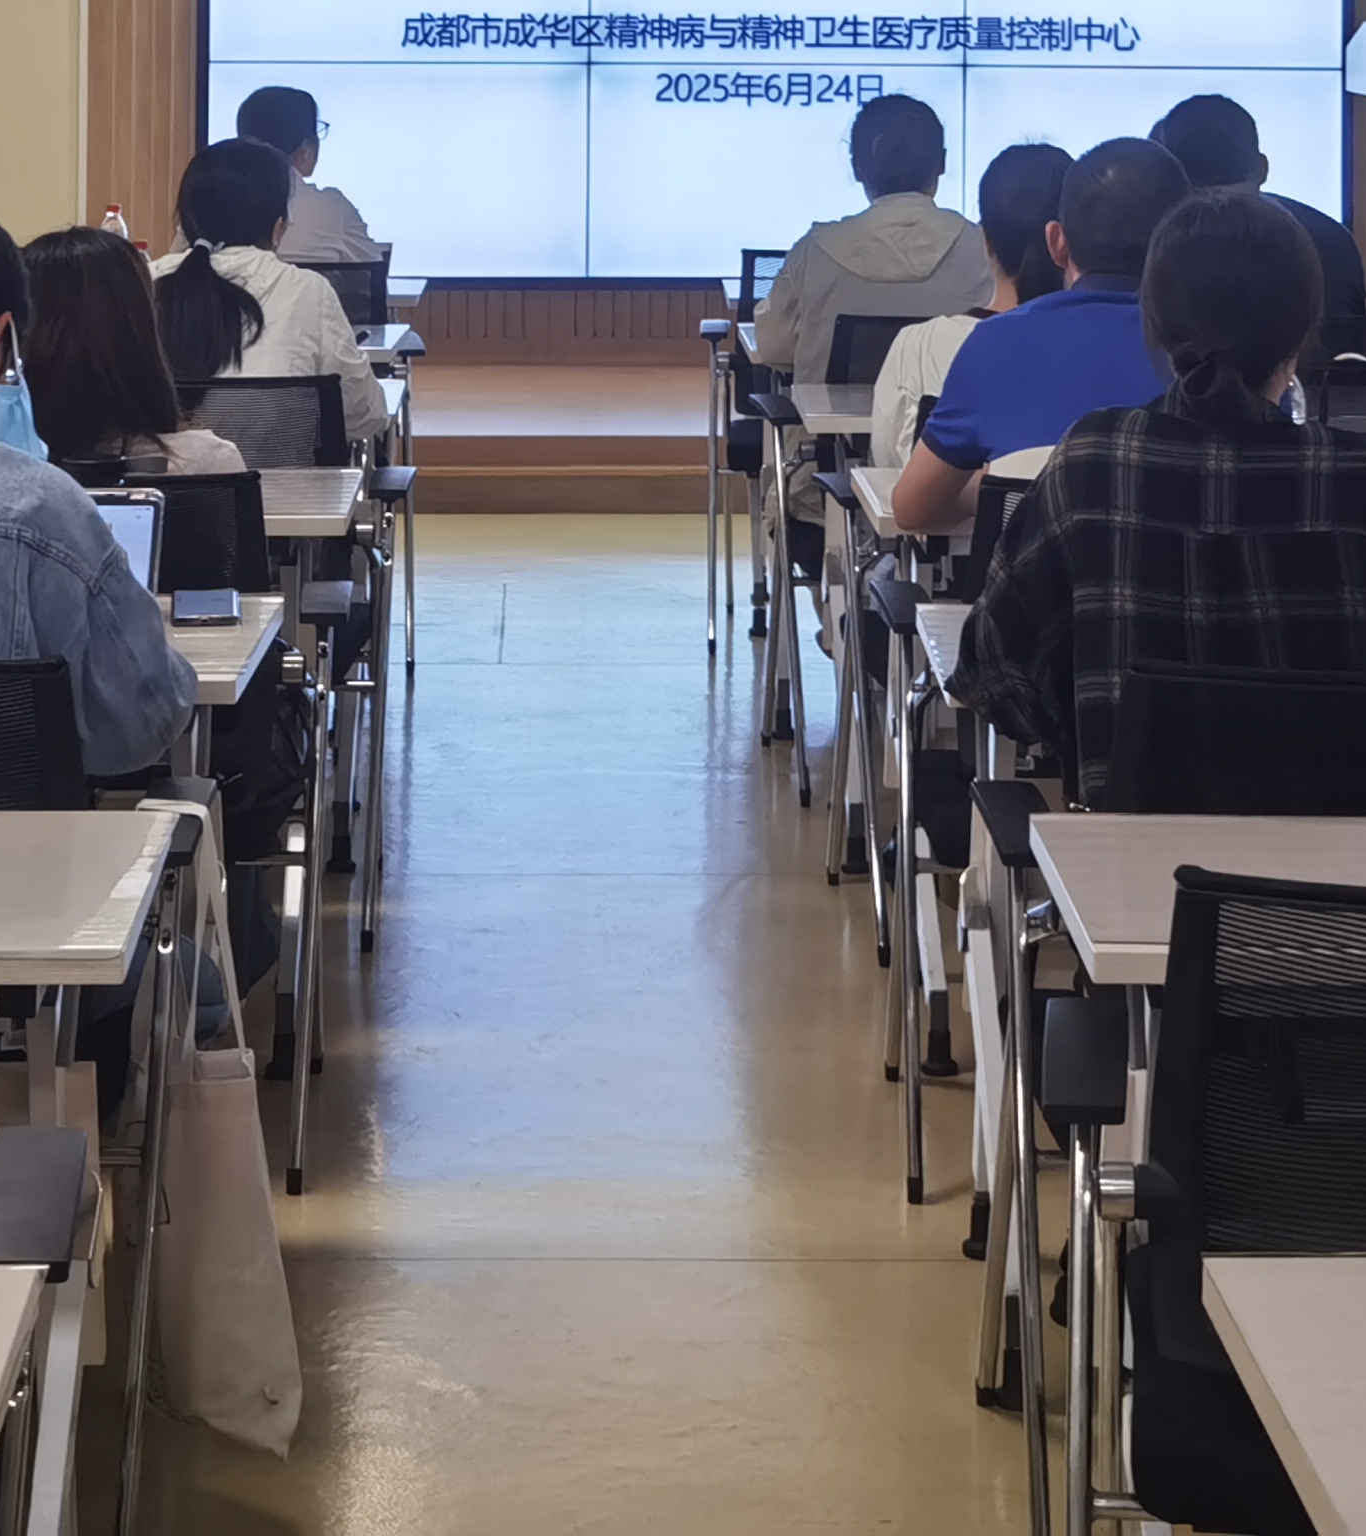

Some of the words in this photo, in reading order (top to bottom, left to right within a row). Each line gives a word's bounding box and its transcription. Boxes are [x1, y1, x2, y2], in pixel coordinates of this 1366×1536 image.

[401, 14, 1141, 54] 成都市成华区精神病与精神卫生医疗质量控制中心
[655, 72, 884, 107] 2025年6月24日
